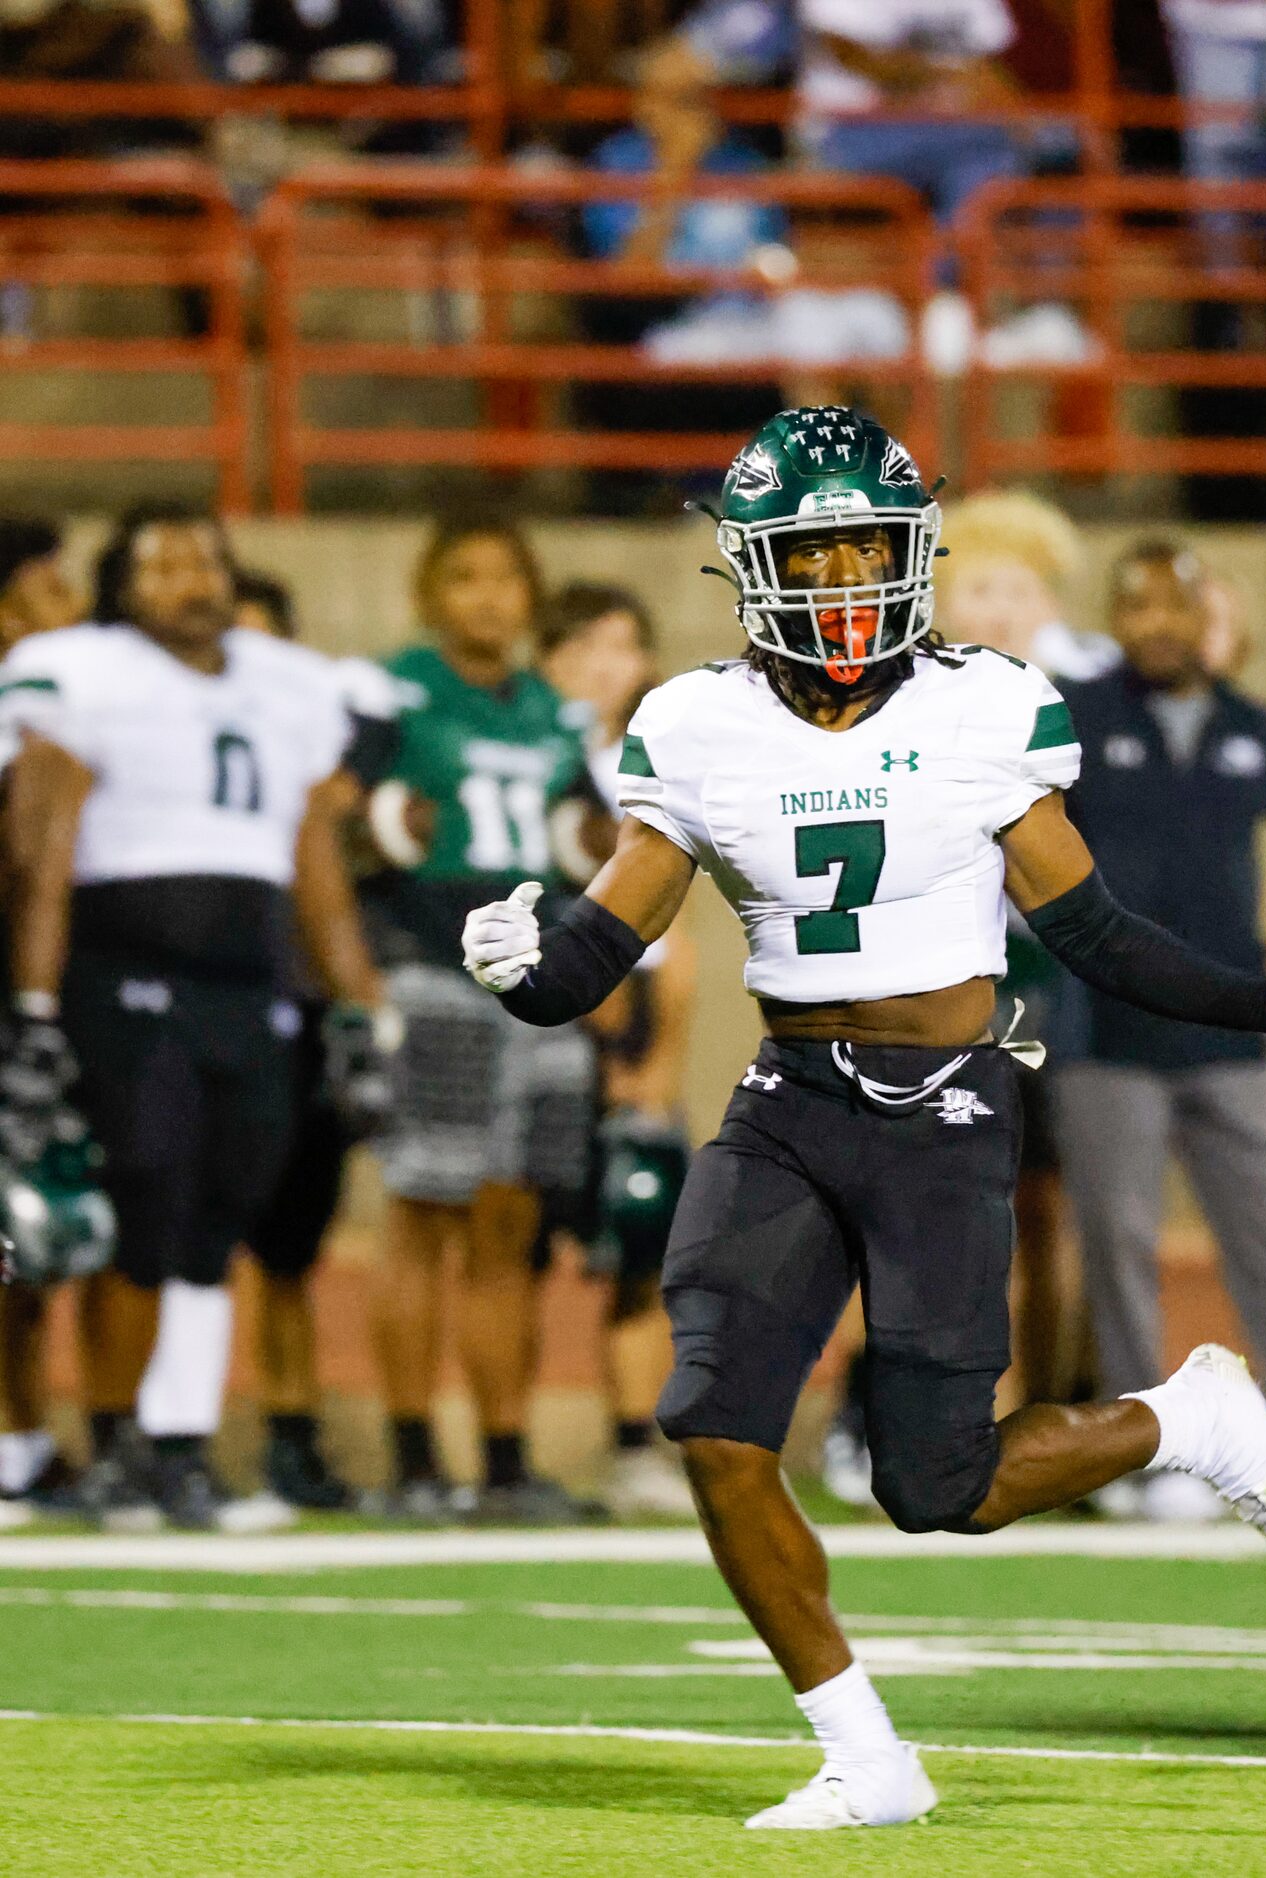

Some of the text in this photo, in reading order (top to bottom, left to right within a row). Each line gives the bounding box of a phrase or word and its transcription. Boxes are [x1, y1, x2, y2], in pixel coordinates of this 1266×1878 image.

[458, 772, 549, 874] 11
[780, 787, 888, 815] INDIANS
[794, 819, 886, 955] 7
